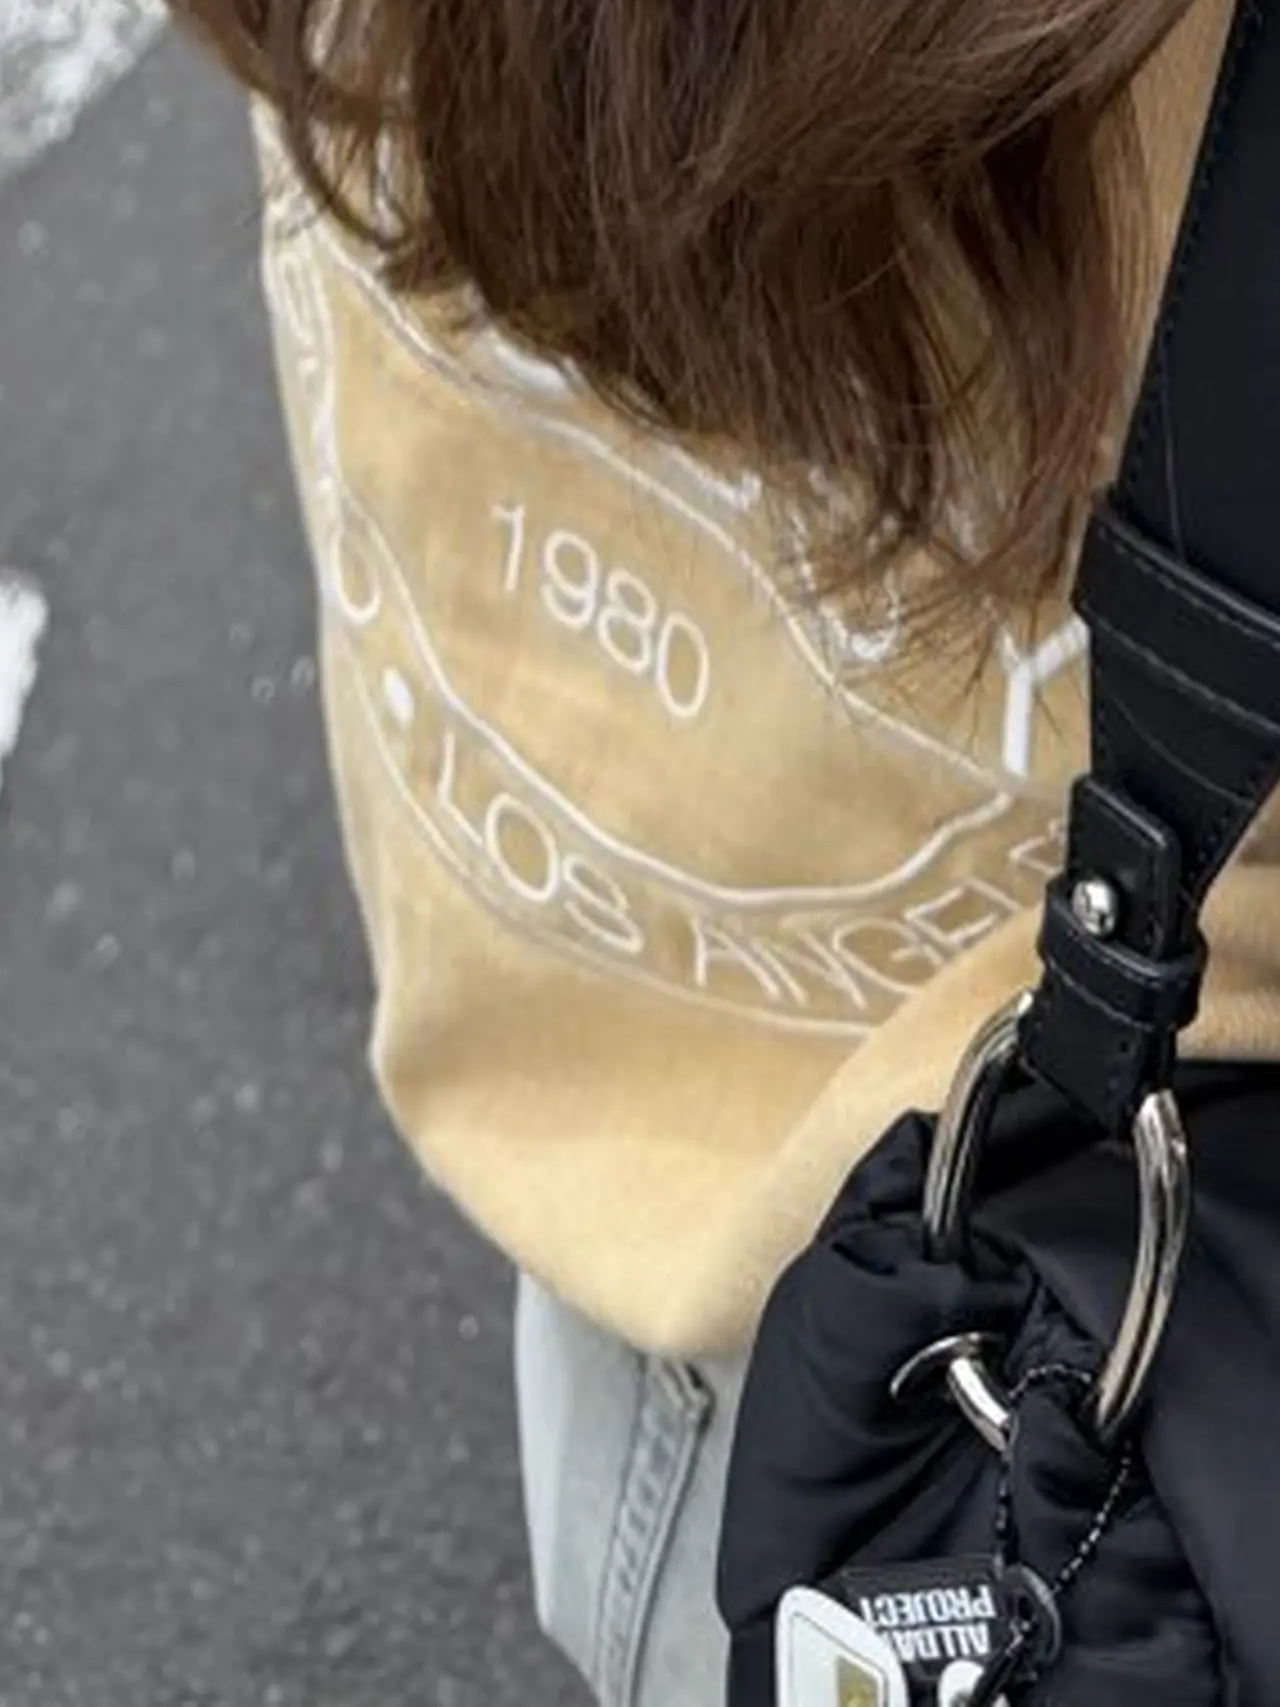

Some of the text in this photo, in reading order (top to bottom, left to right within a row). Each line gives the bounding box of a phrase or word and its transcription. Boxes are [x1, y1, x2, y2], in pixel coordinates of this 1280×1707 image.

[488, 499, 711, 721] 1980
[437, 729, 1066, 1011] LOS ANGEL
[859, 1584, 998, 1629] PROJECT
